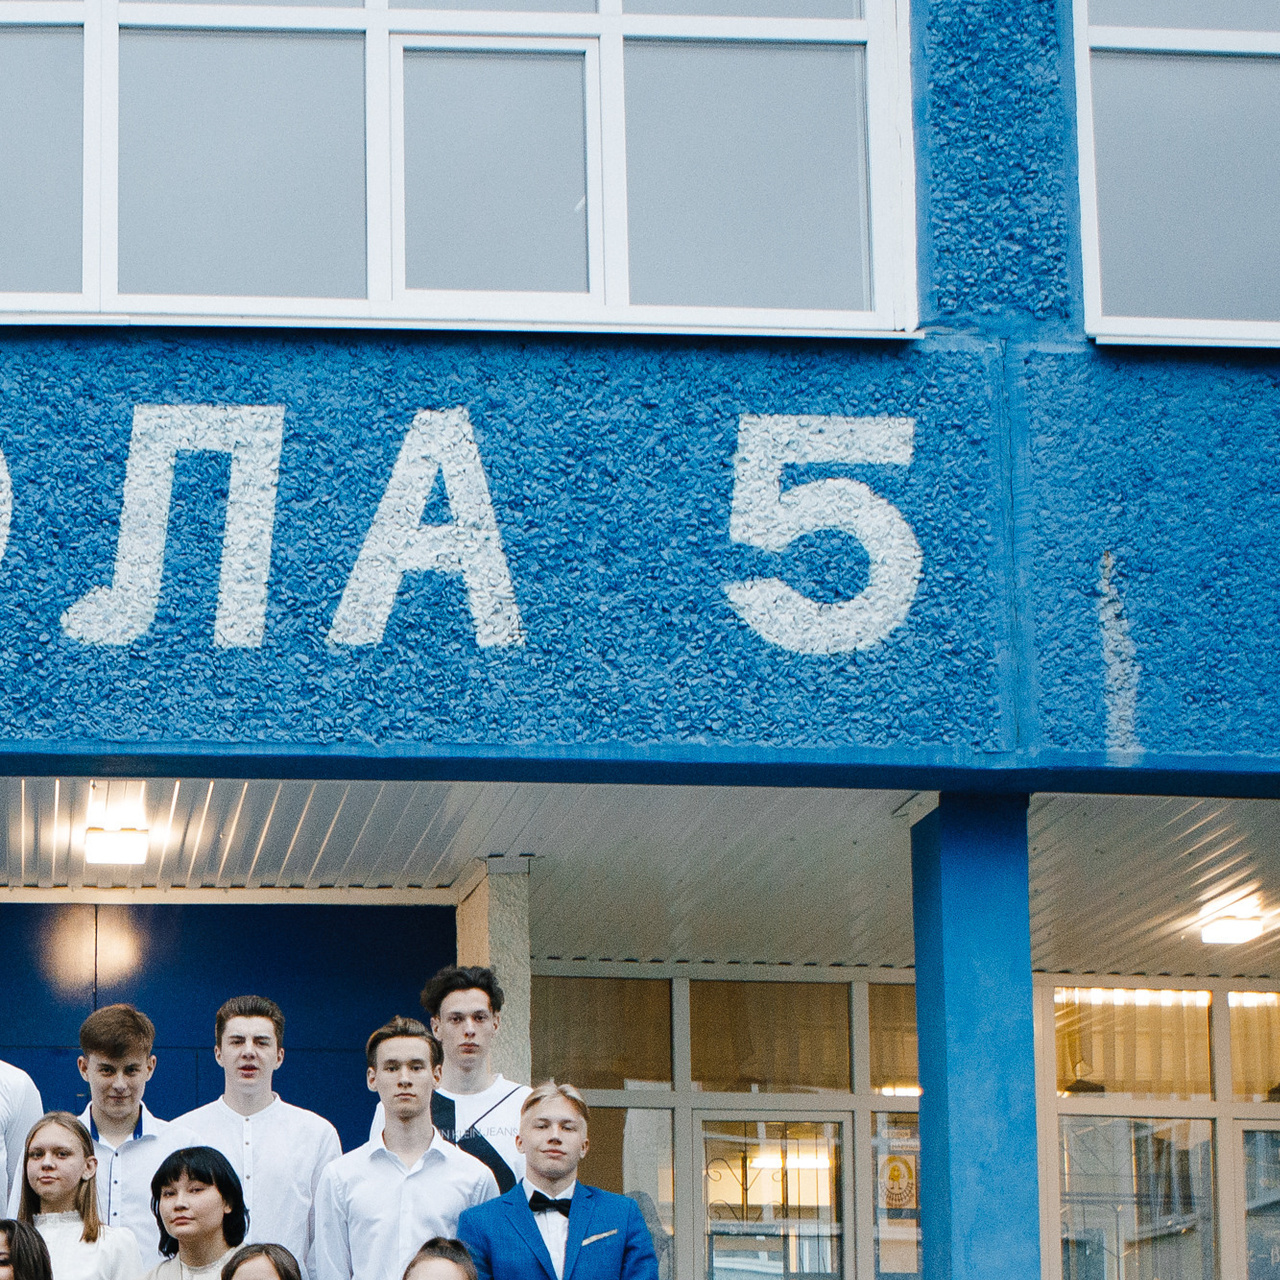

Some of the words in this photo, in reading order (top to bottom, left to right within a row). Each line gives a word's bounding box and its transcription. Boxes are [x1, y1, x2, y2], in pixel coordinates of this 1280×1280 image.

[725, 413, 923, 655] 5
[452, 1127, 482, 1140] KLEIN
[485, 1127, 518, 1138] JEANS
